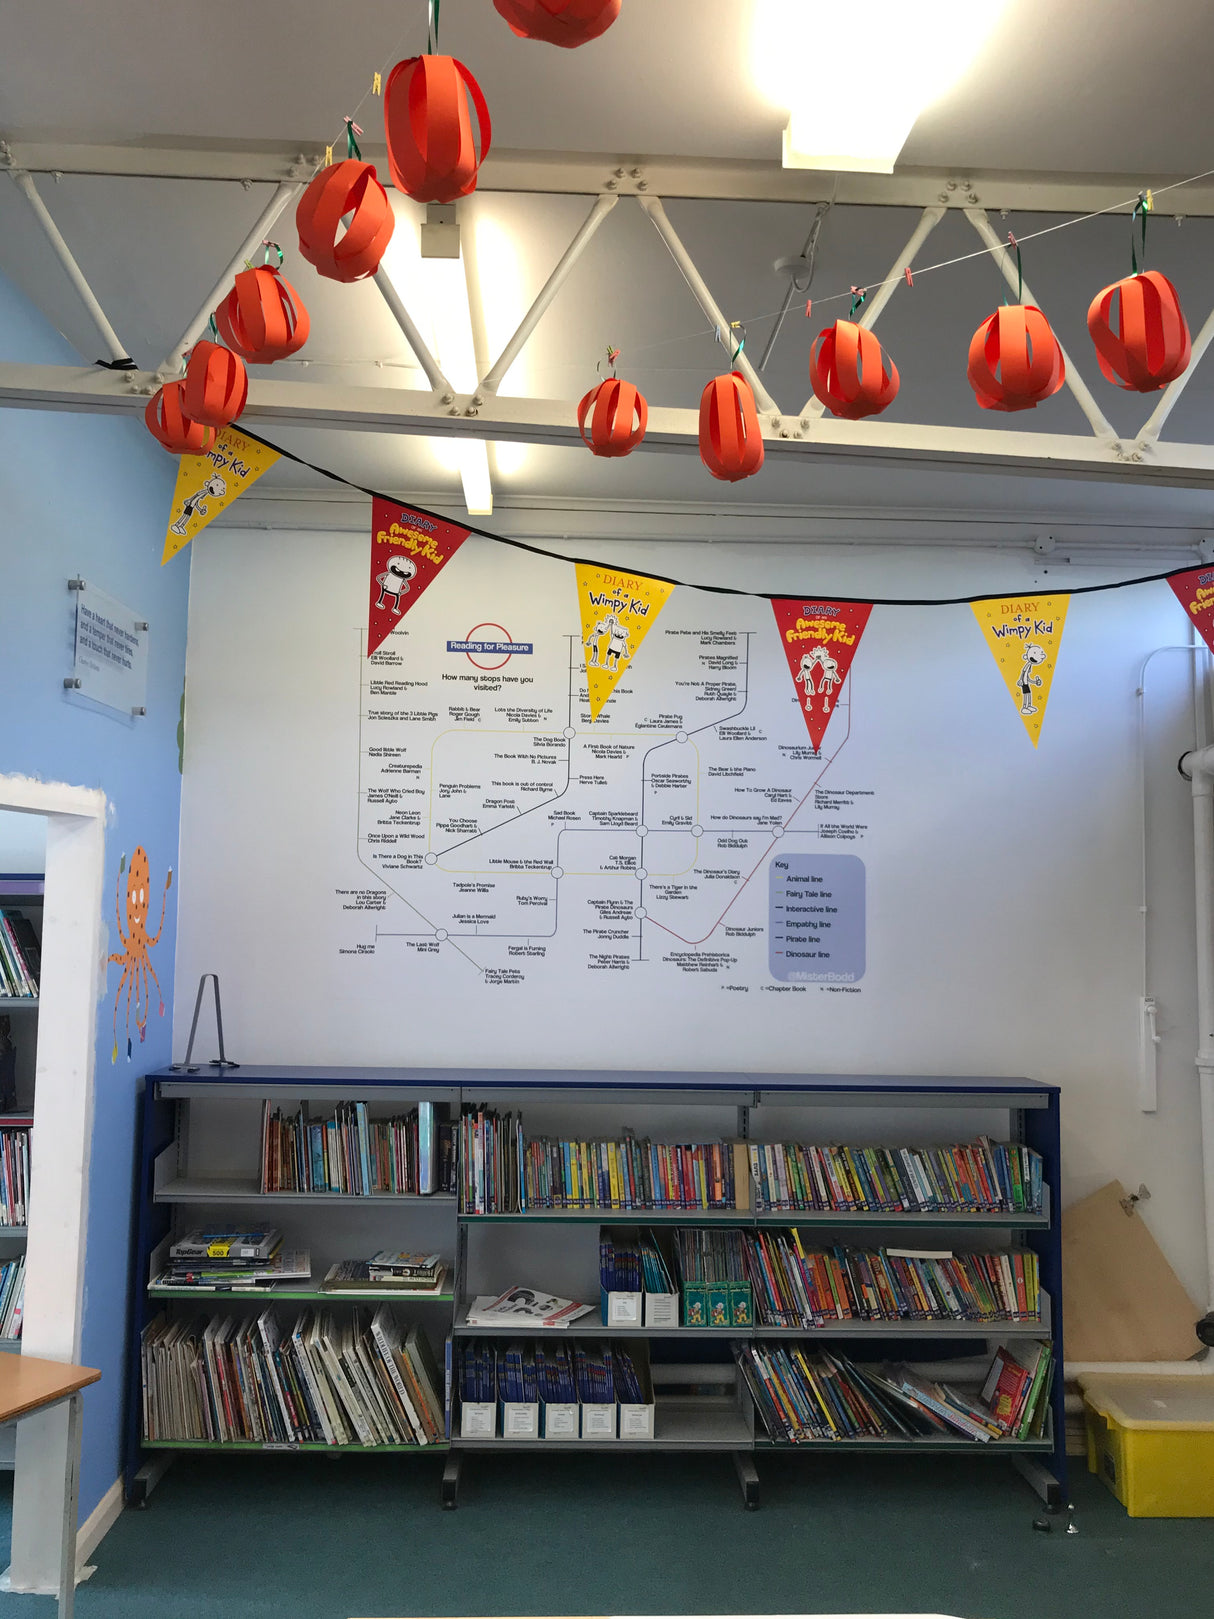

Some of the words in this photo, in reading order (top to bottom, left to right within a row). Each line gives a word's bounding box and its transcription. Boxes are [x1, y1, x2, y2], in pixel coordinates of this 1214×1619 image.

[218, 444, 228, 452] of
[206, 451, 230, 468] mpy
[229, 458, 250, 478] Kid
[401, 513, 438, 532] DIARY
[390, 522, 438, 548] Awesome
[377, 531, 422, 556] Friendly
[421, 545, 444, 565] Kid
[603, 574, 643, 591] DIARY
[612, 588, 622, 596] of
[589, 592, 627, 613] Wimpy
[629, 599, 650, 616] Kid
[803, 606, 840, 616] DIARY
[1001, 602, 1040, 614] DIARY
[796, 618, 846, 631] Awesome
[992, 624, 1031, 639] Wimpy
[1034, 620, 1053, 634] Kid
[786, 629, 832, 644] Friendly
[832, 629, 855, 646] Kid
[451, 642, 481, 651] Reading
[786, 921, 818, 929] Empathy
